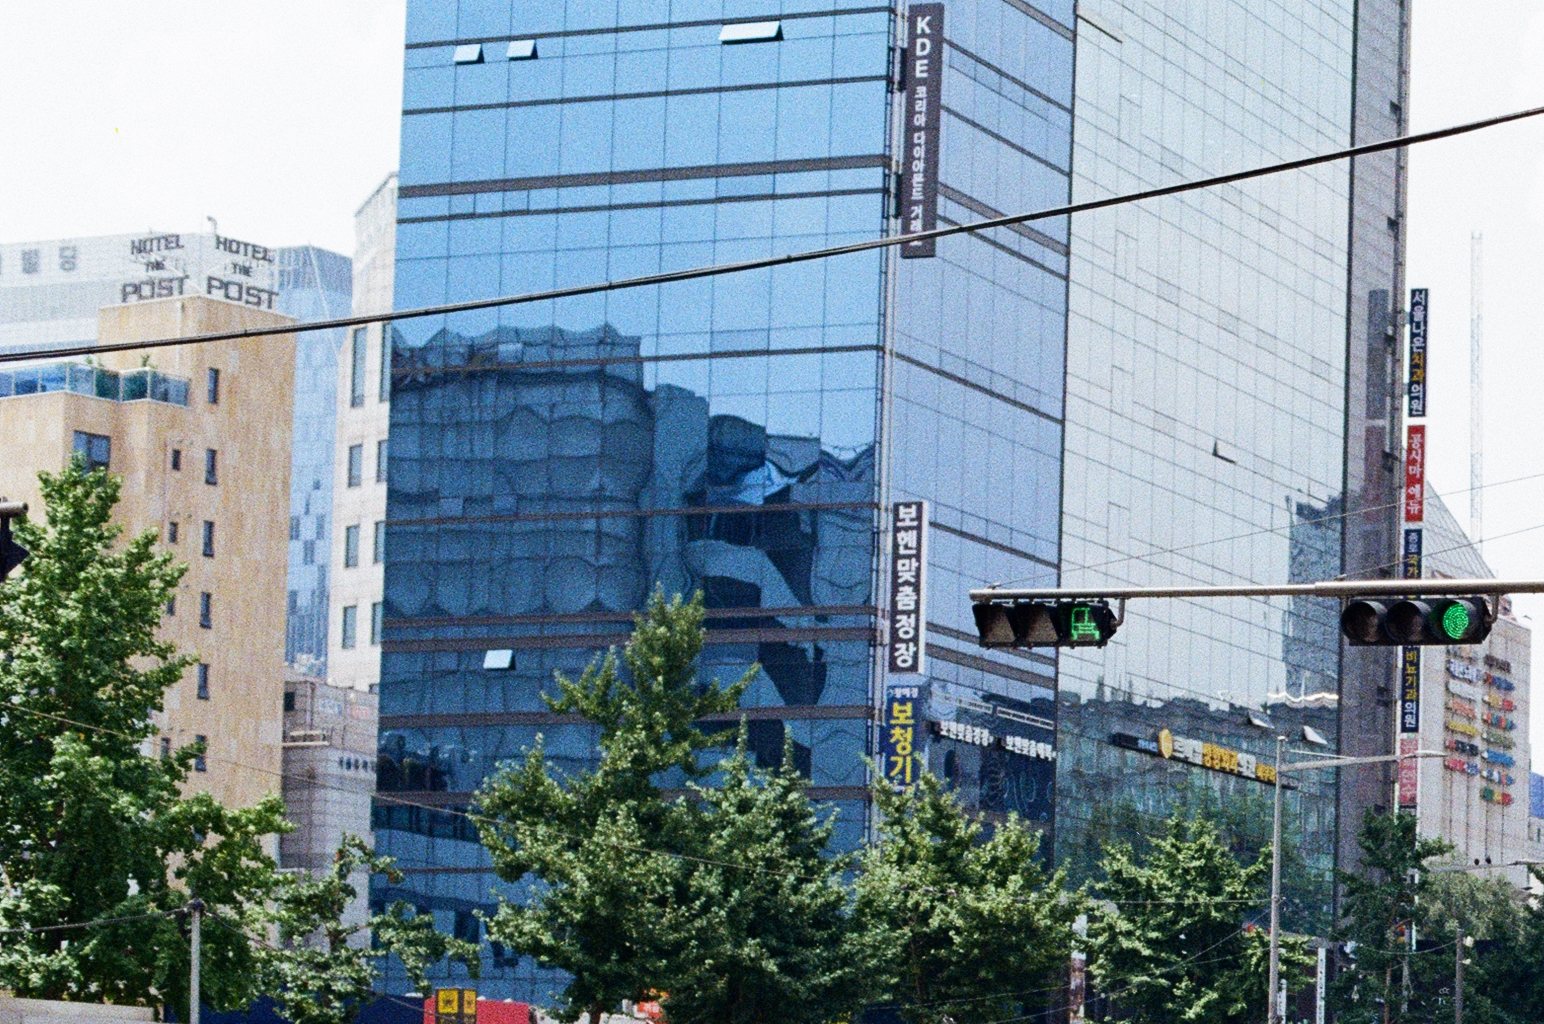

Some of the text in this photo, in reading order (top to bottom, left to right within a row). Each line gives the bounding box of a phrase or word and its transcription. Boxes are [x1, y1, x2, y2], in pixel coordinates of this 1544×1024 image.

[915, 15, 931, 78] KDE
[131, 234, 185, 255] HOTEL
[215, 234, 273, 263] HOTEL
[121, 275, 189, 303] POST
[206, 275, 279, 310] POST
[889, 702, 915, 784] 보청기
